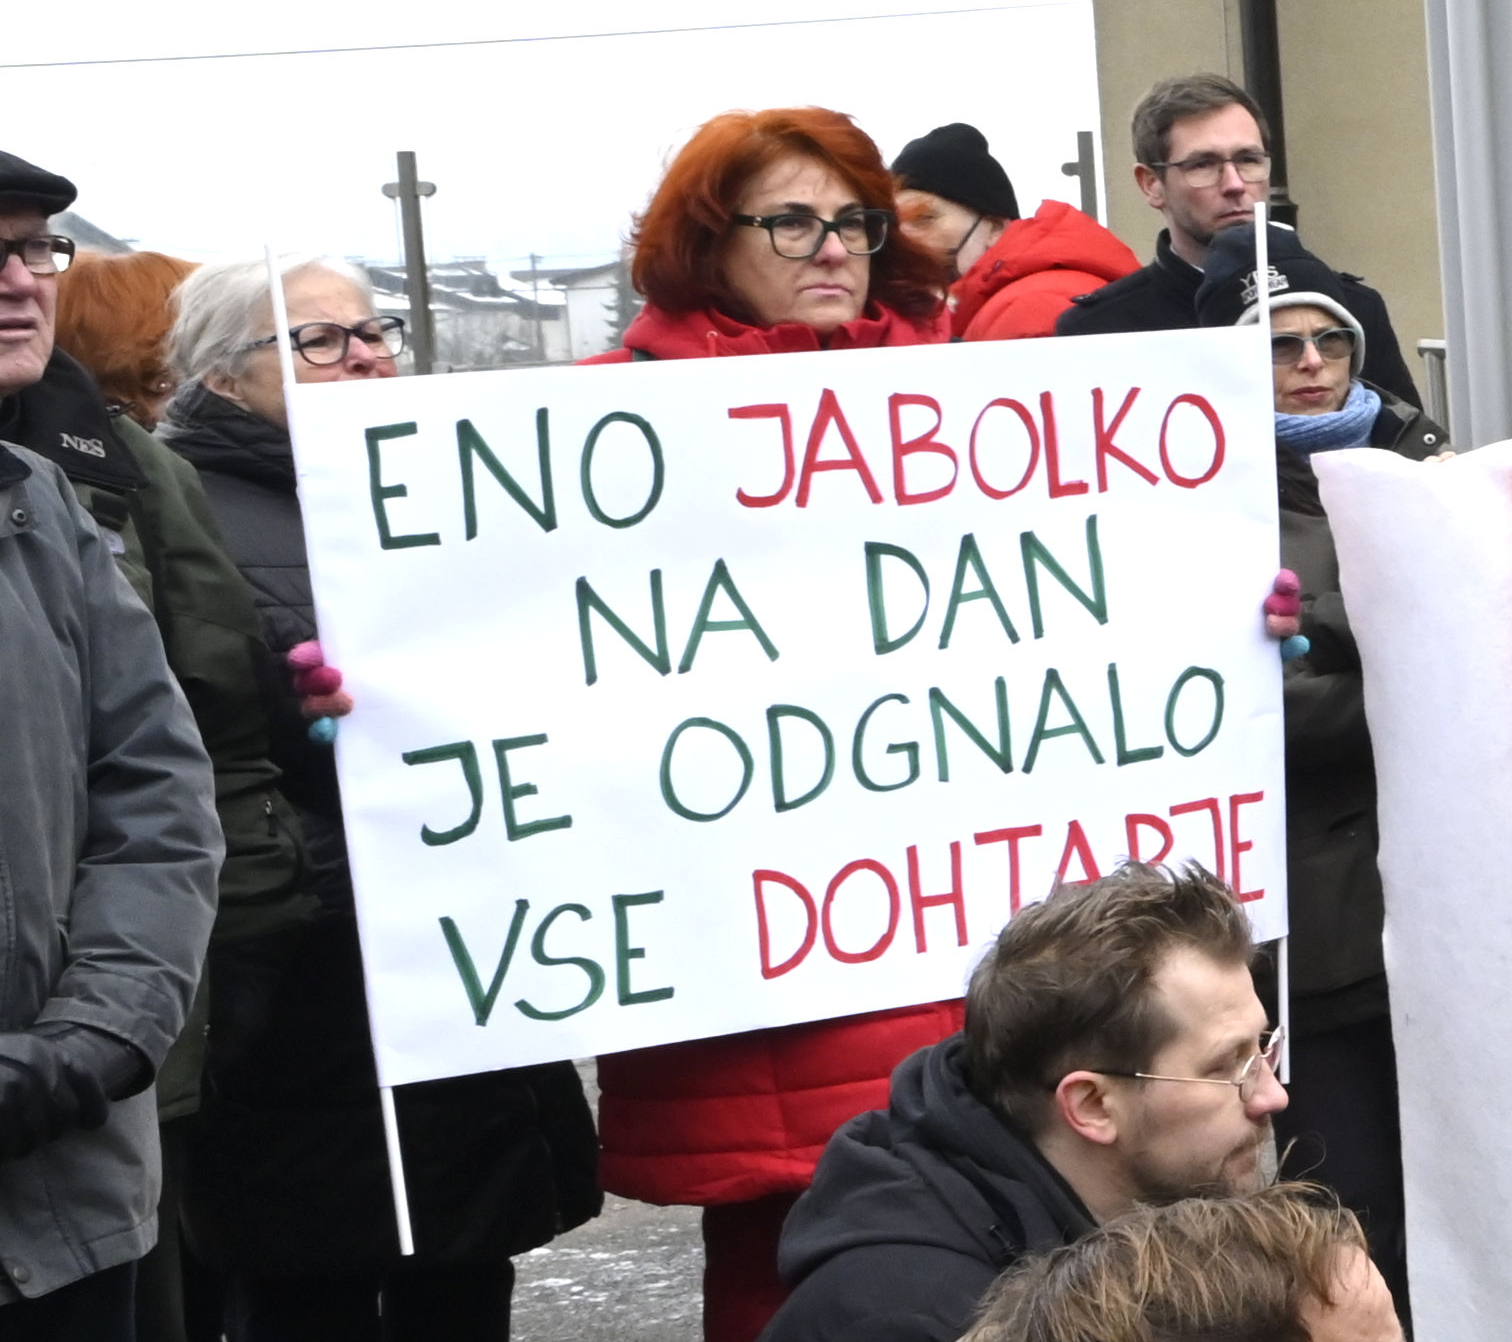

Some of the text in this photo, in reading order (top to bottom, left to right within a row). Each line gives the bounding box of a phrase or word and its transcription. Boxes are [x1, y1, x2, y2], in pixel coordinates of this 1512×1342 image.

[364, 385, 1227, 551] ENO JABOLKO
[575, 514, 1109, 686] NA DAN
[401, 664, 1225, 847] JE ODGNALO
[440, 889, 675, 1027] VSE
